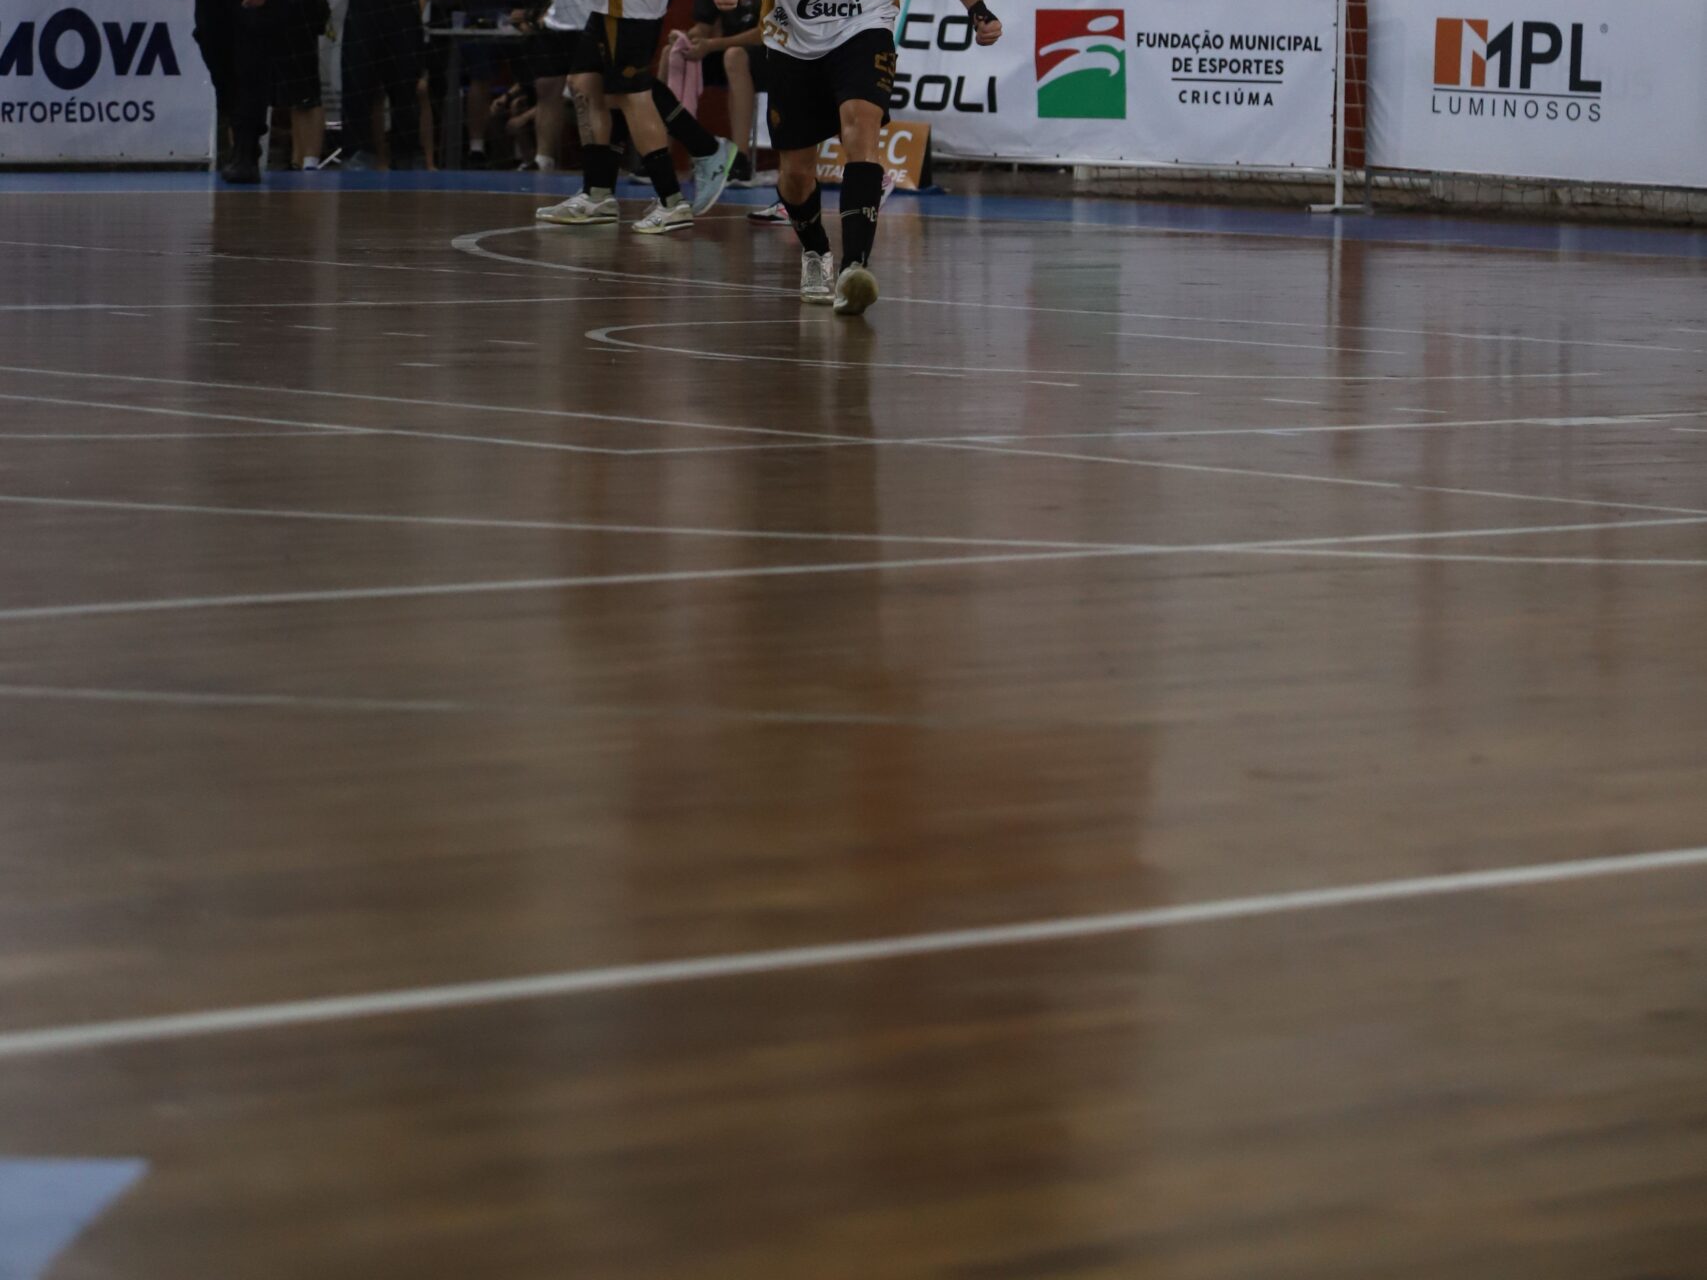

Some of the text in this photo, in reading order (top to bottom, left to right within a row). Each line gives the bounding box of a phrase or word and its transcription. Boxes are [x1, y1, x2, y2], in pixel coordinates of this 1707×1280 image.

[1136, 31, 1322, 54] FUNDAÇÃO MUNICIPAL
[1172, 57, 1284, 75] DE ESPORTES
[1434, 17, 1602, 93] MPL
[1178, 88, 1274, 106] CRICIÚMA
[1432, 95, 1601, 122] LUMINOSOS
[0, 97, 155, 123] RTOPÉDICOS
